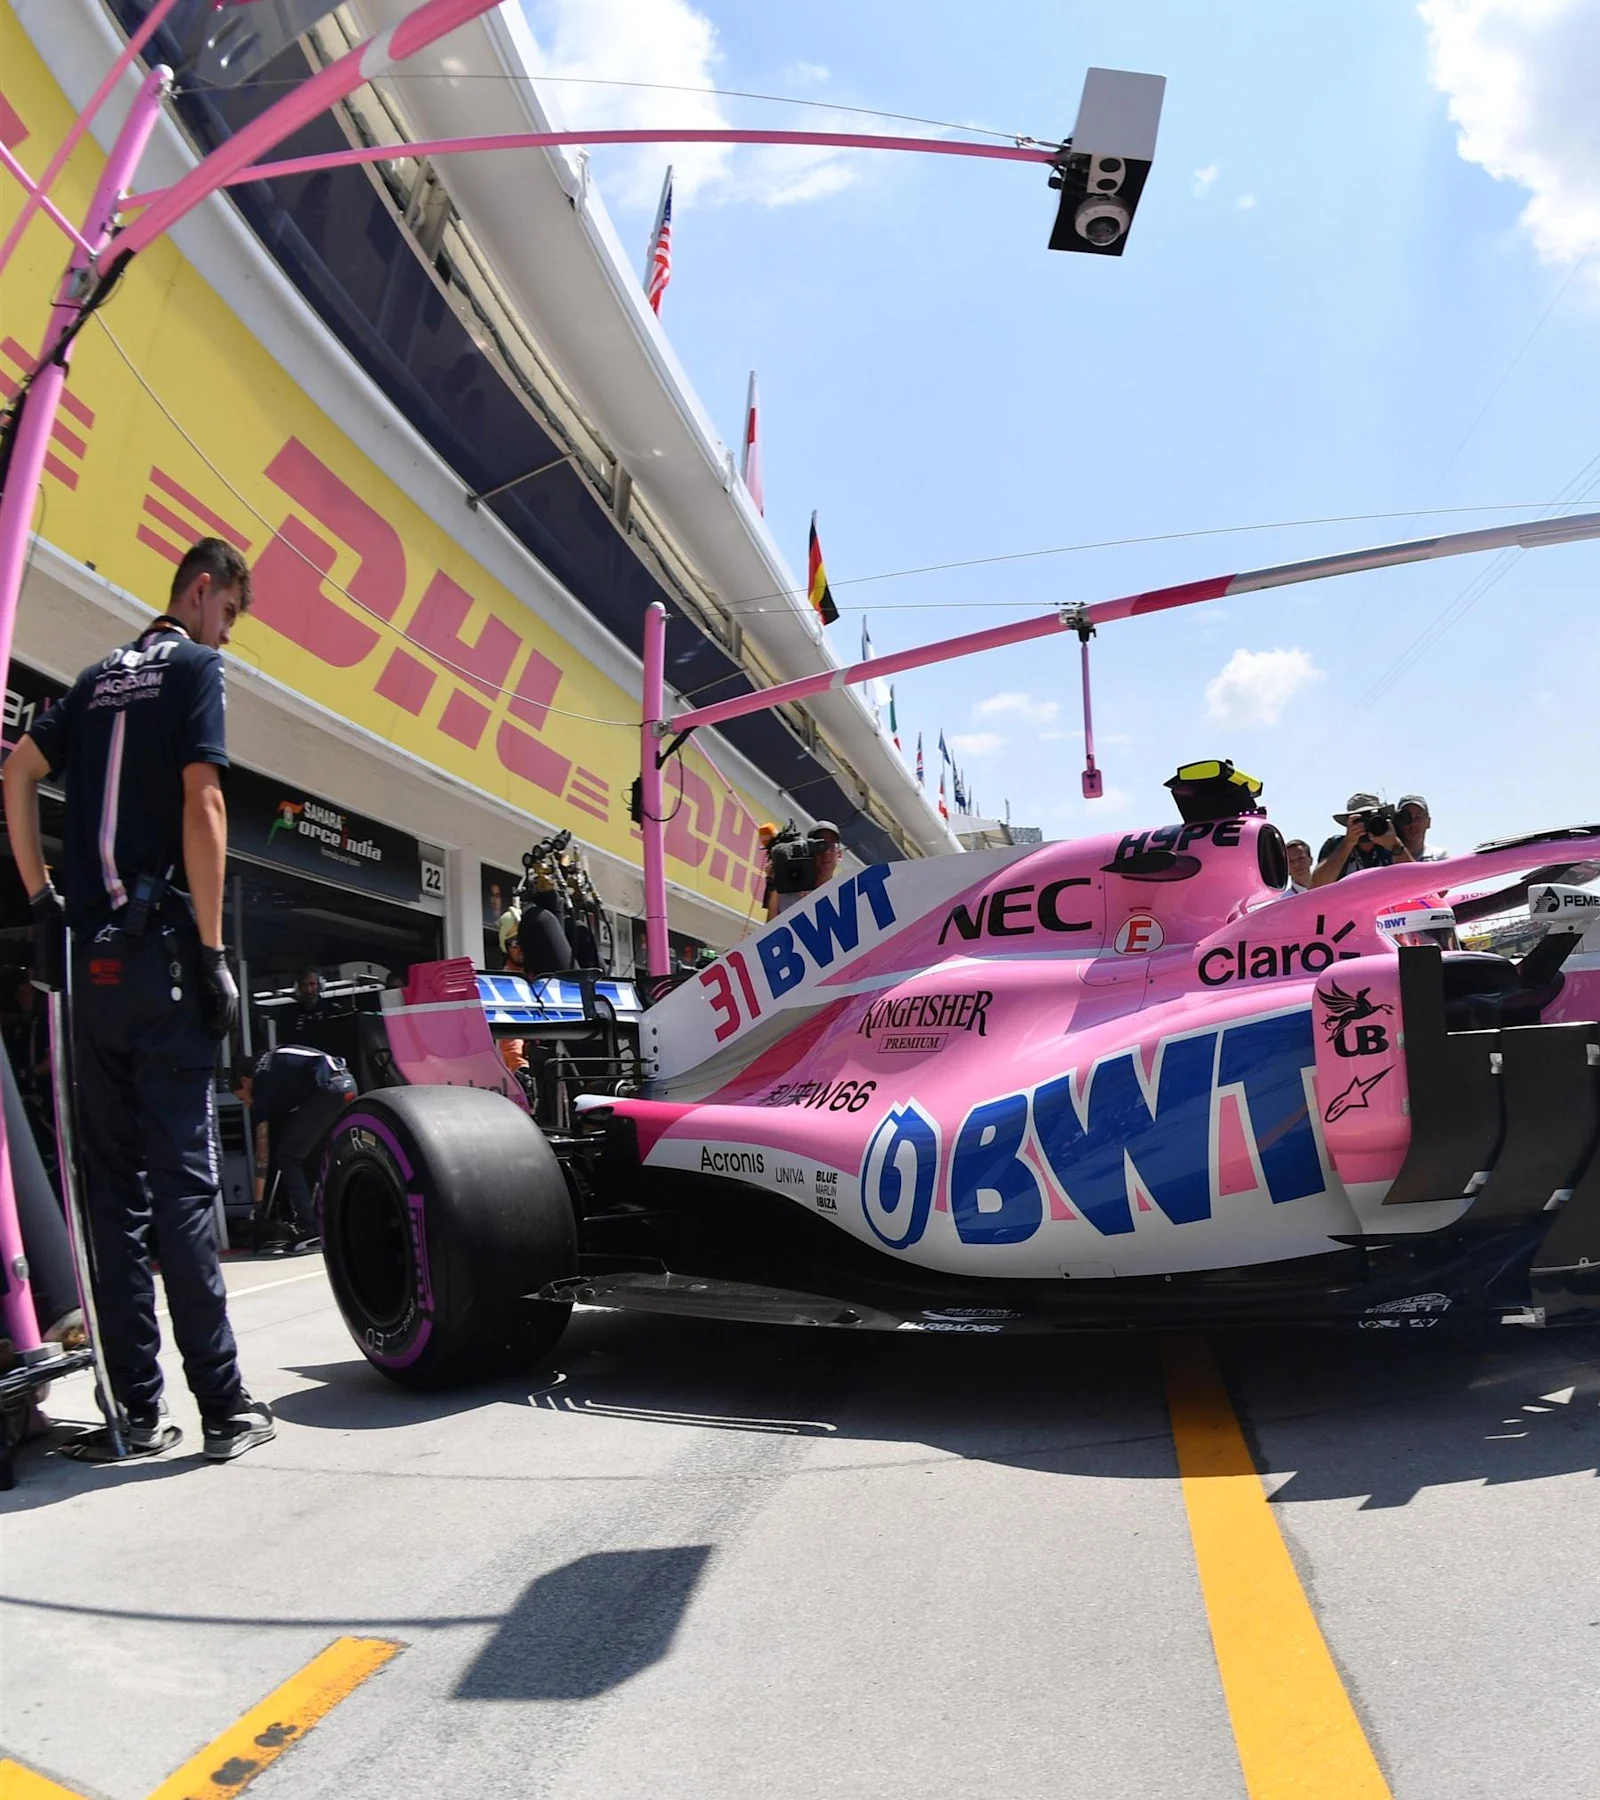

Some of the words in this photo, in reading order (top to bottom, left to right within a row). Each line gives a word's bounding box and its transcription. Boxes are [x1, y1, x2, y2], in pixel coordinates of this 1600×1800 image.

[249, 434, 574, 798] DHL
[303, 801, 343, 831] SAHARA
[1114, 819, 1248, 865] HYPE
[425, 866, 442, 891] 22
[937, 877, 1093, 946] NEC
[1384, 917, 1406, 929] BWT
[756, 863, 897, 1000] BWT
[1123, 920, 1153, 953] E
[1197, 938, 1335, 987] Claro
[698, 951, 762, 1043] 31
[857, 990, 993, 1039] KINGFISHER
[884, 1036, 941, 1050] PREMIUM
[1333, 1024, 1390, 1058] UB
[350, 1126, 364, 1152] R
[950, 1008, 1327, 1246] BWT
[701, 1145, 765, 1174] Acronis
[775, 1167, 805, 1185] UNIVA
[815, 1184, 837, 1197] MARLIN
[816, 1170, 838, 1184] BLUE
[816, 1196, 837, 1211] IBIZA
